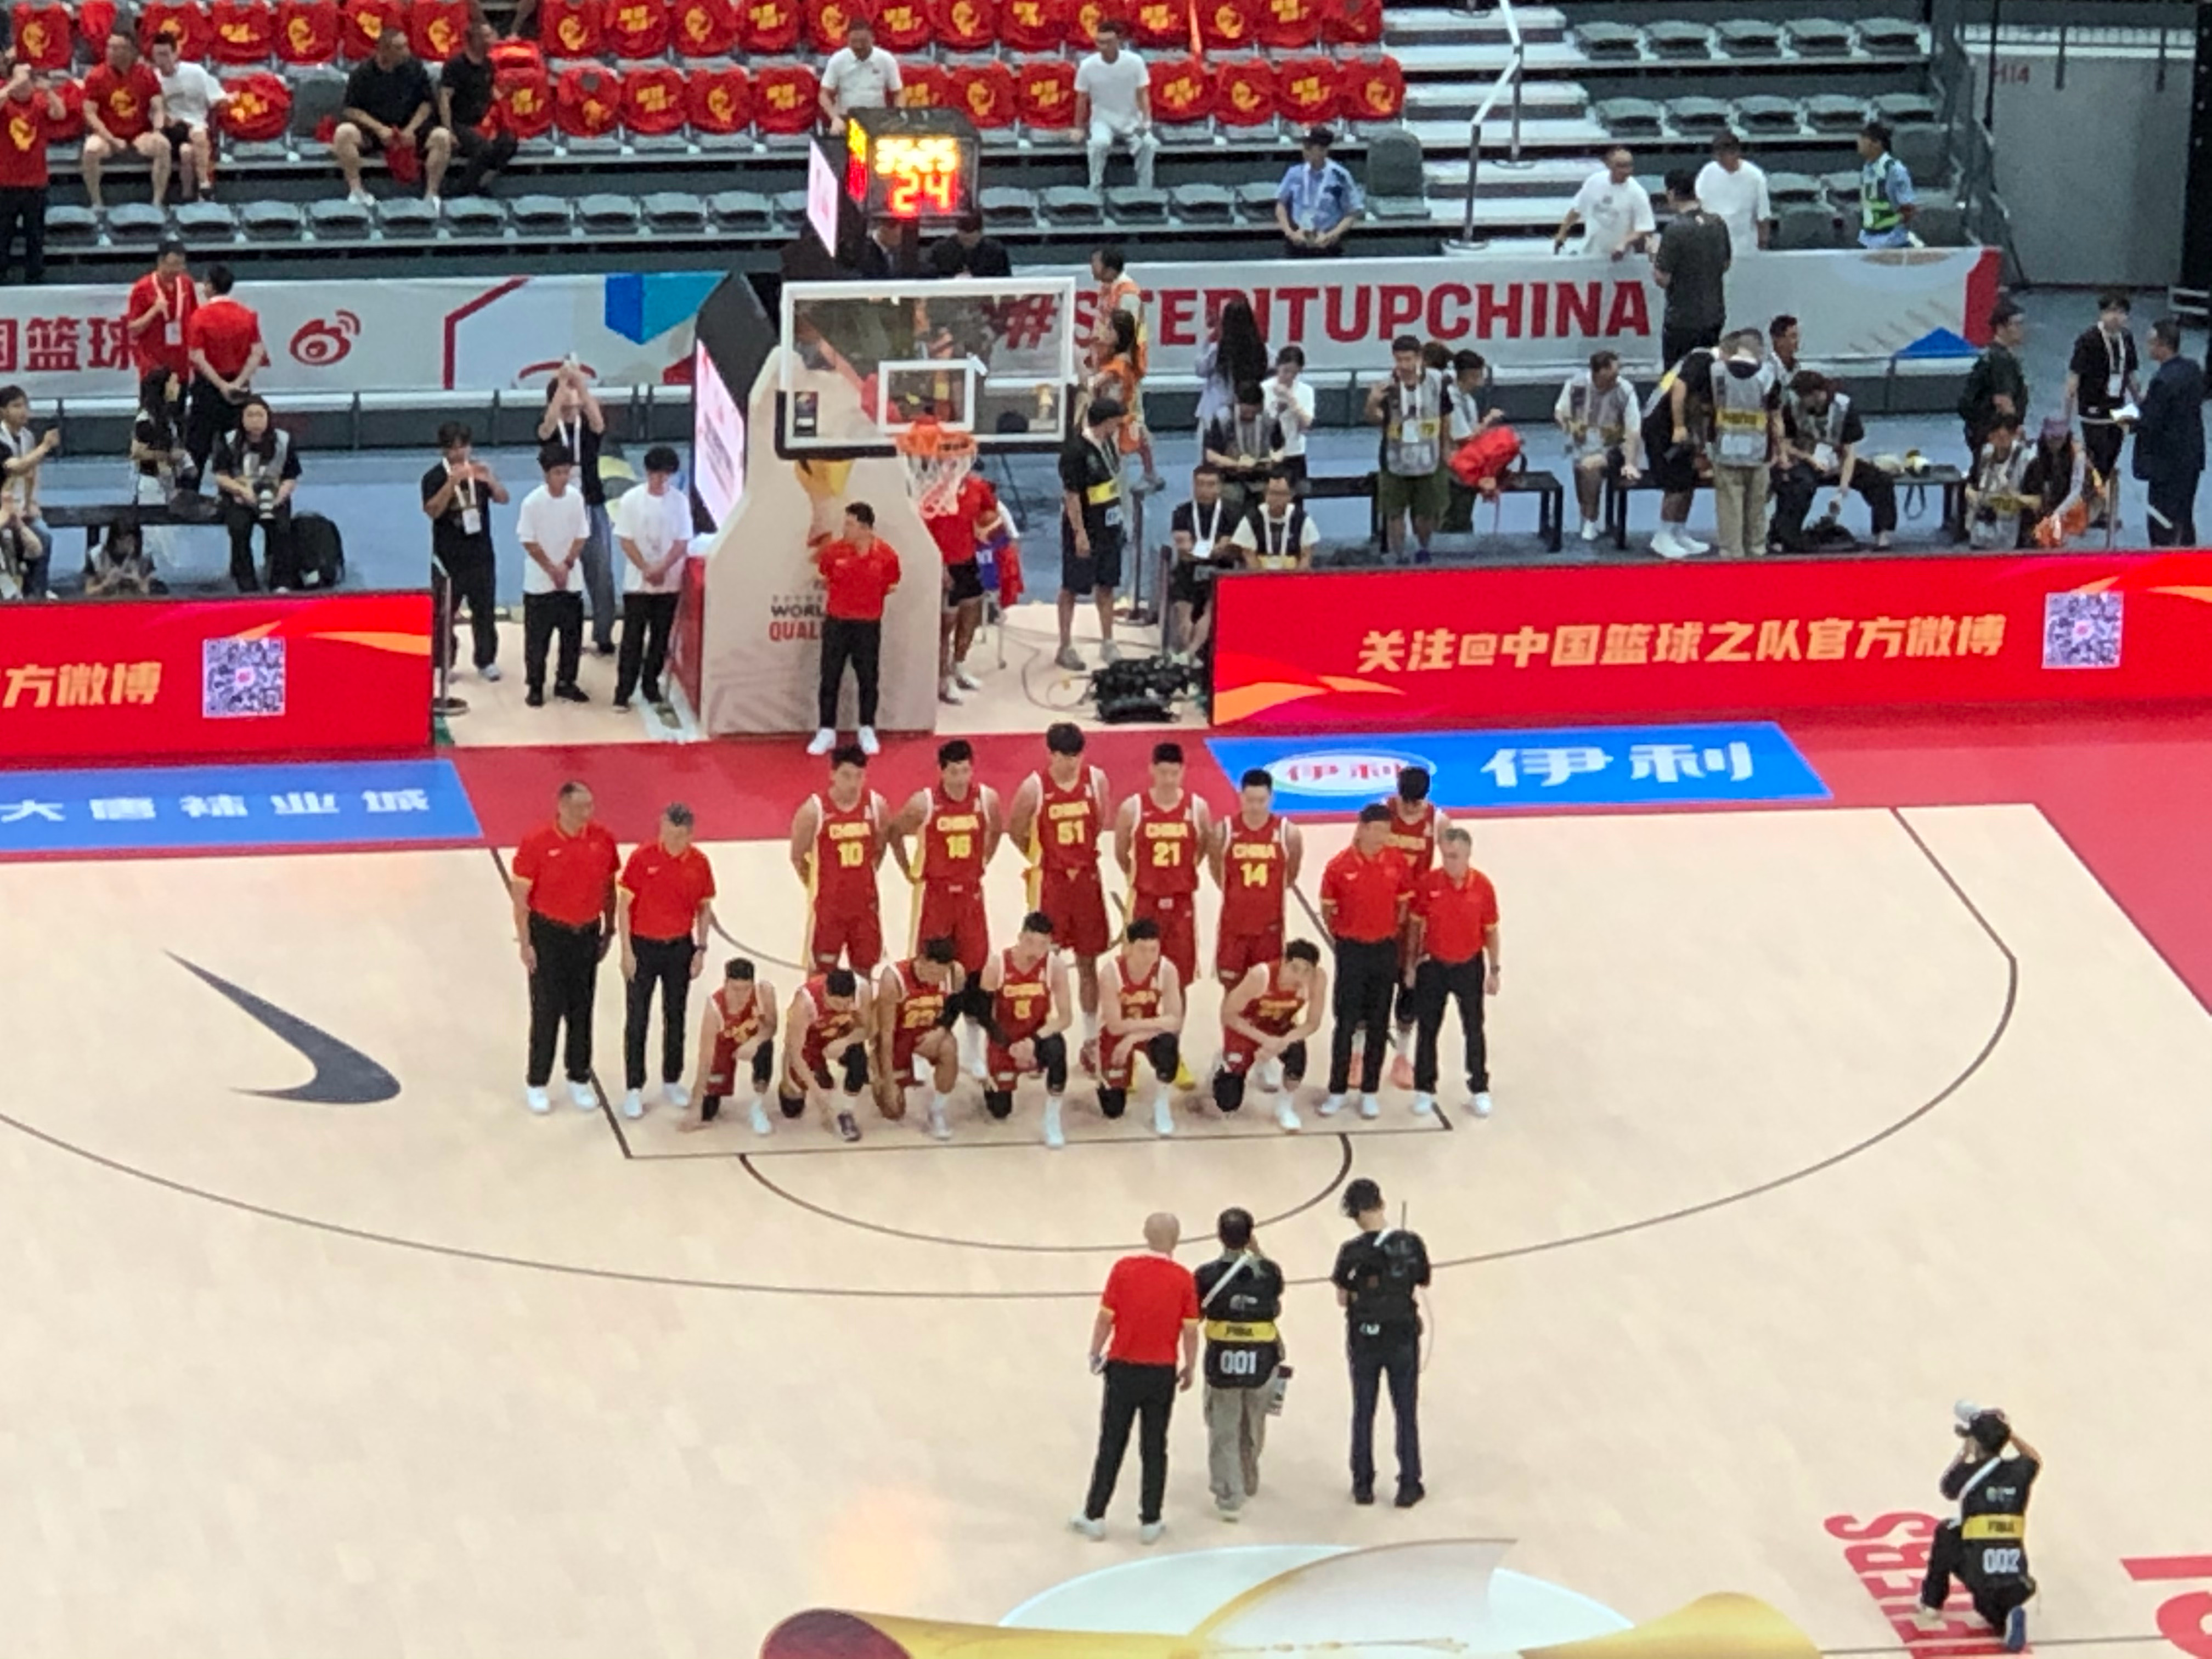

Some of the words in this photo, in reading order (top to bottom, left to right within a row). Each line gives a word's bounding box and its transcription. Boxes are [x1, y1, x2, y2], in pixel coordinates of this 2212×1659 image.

[893, 171, 950, 212] 24
[770, 604, 826, 618] WORL
[769, 621, 819, 641] QUAL
[1357, 614, 2007, 674] 关注@中国篮球之队官方微博
[2, 661, 162, 708] 方微博
[1481, 742, 1753, 787] 伊利
[837, 842, 864, 867] 10
[1153, 842, 1181, 867] 21
[1240, 862, 1268, 887] 14
[1220, 1350, 1257, 1374] 001
[1983, 1548, 2021, 1573] 002
